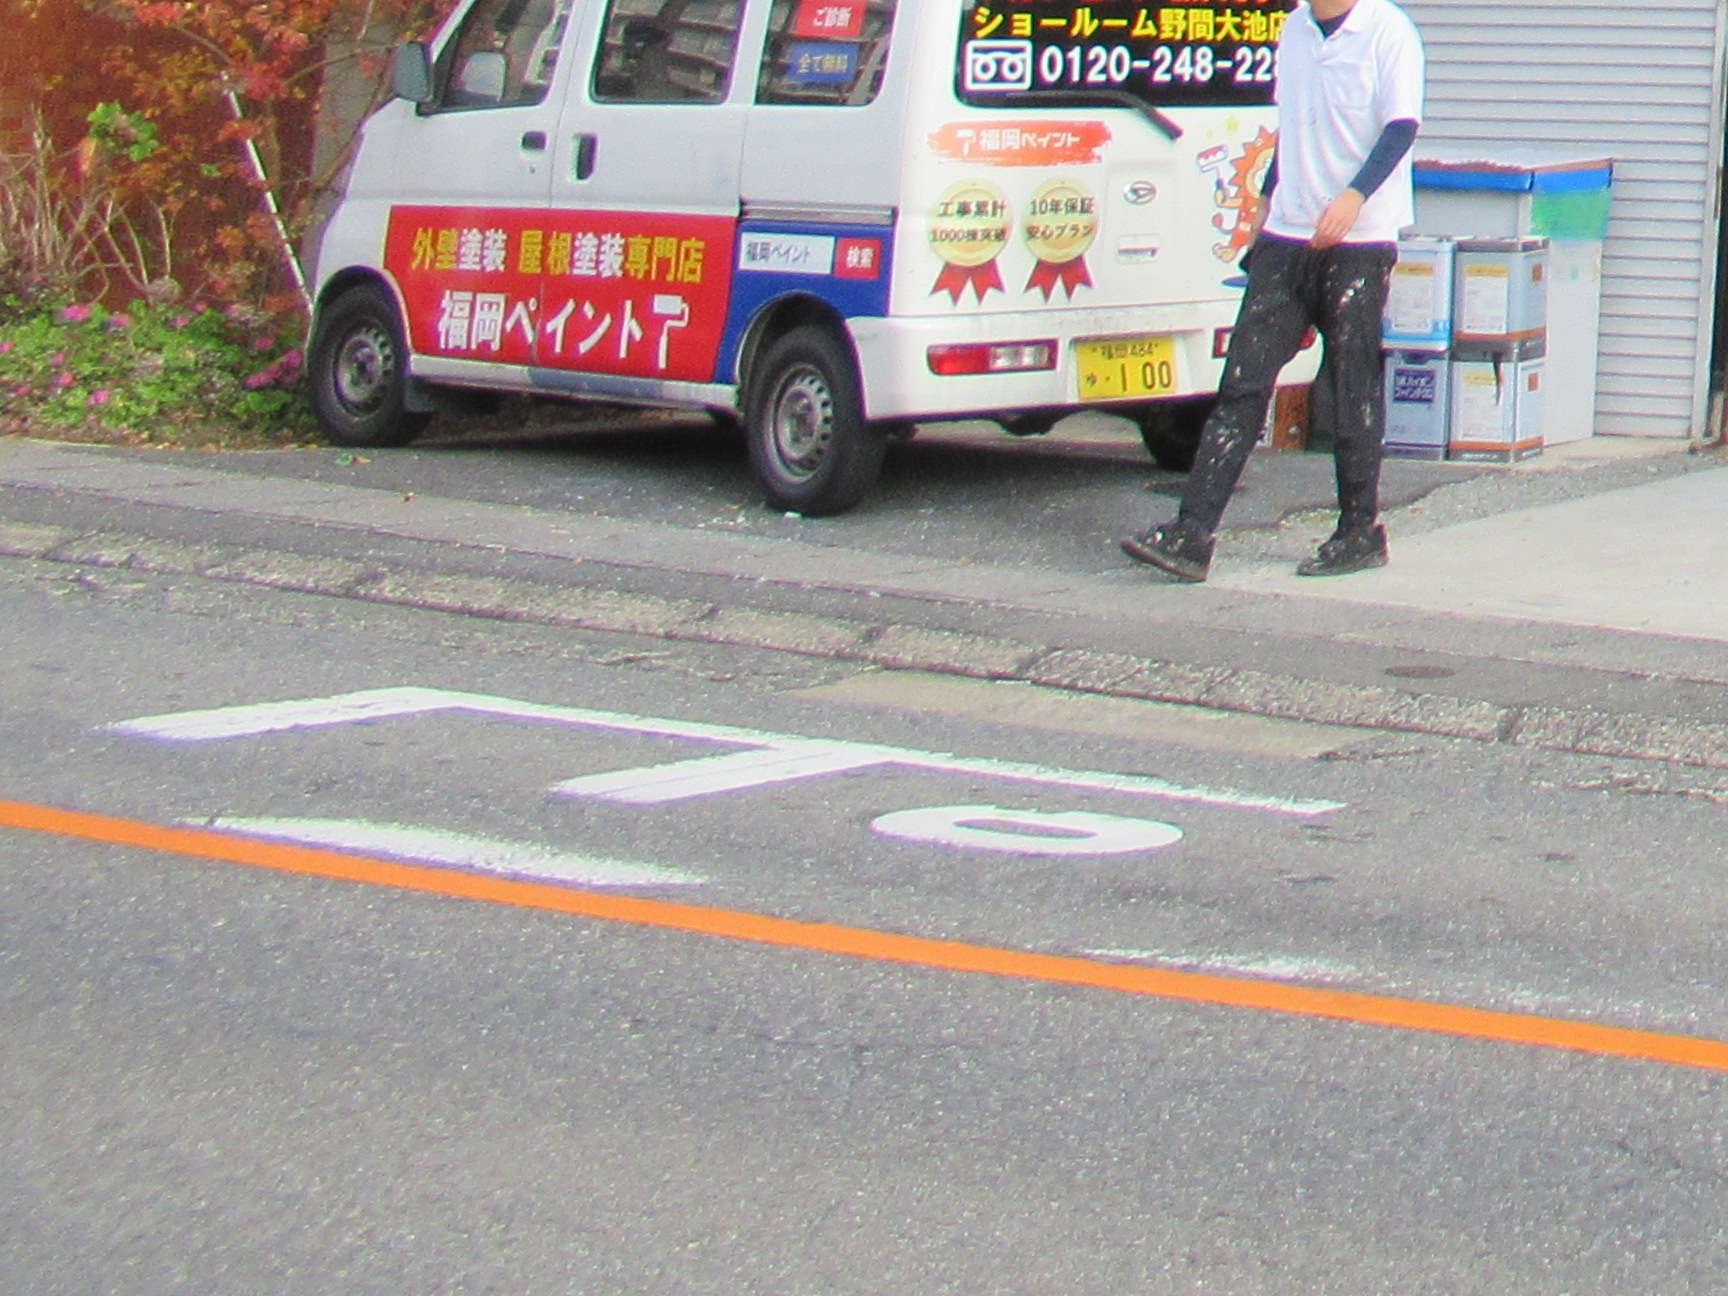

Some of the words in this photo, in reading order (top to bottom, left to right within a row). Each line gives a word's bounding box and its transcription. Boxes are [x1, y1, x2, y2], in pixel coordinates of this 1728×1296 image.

[1040, 44, 1279, 82] 0120-248-22
[980, 128, 1081, 150] 福岡ペイント
[411, 227, 507, 272] 外壁塗装
[518, 229, 705, 283] 屋根塗装専門店
[438, 290, 643, 358] 福岡ペイント
